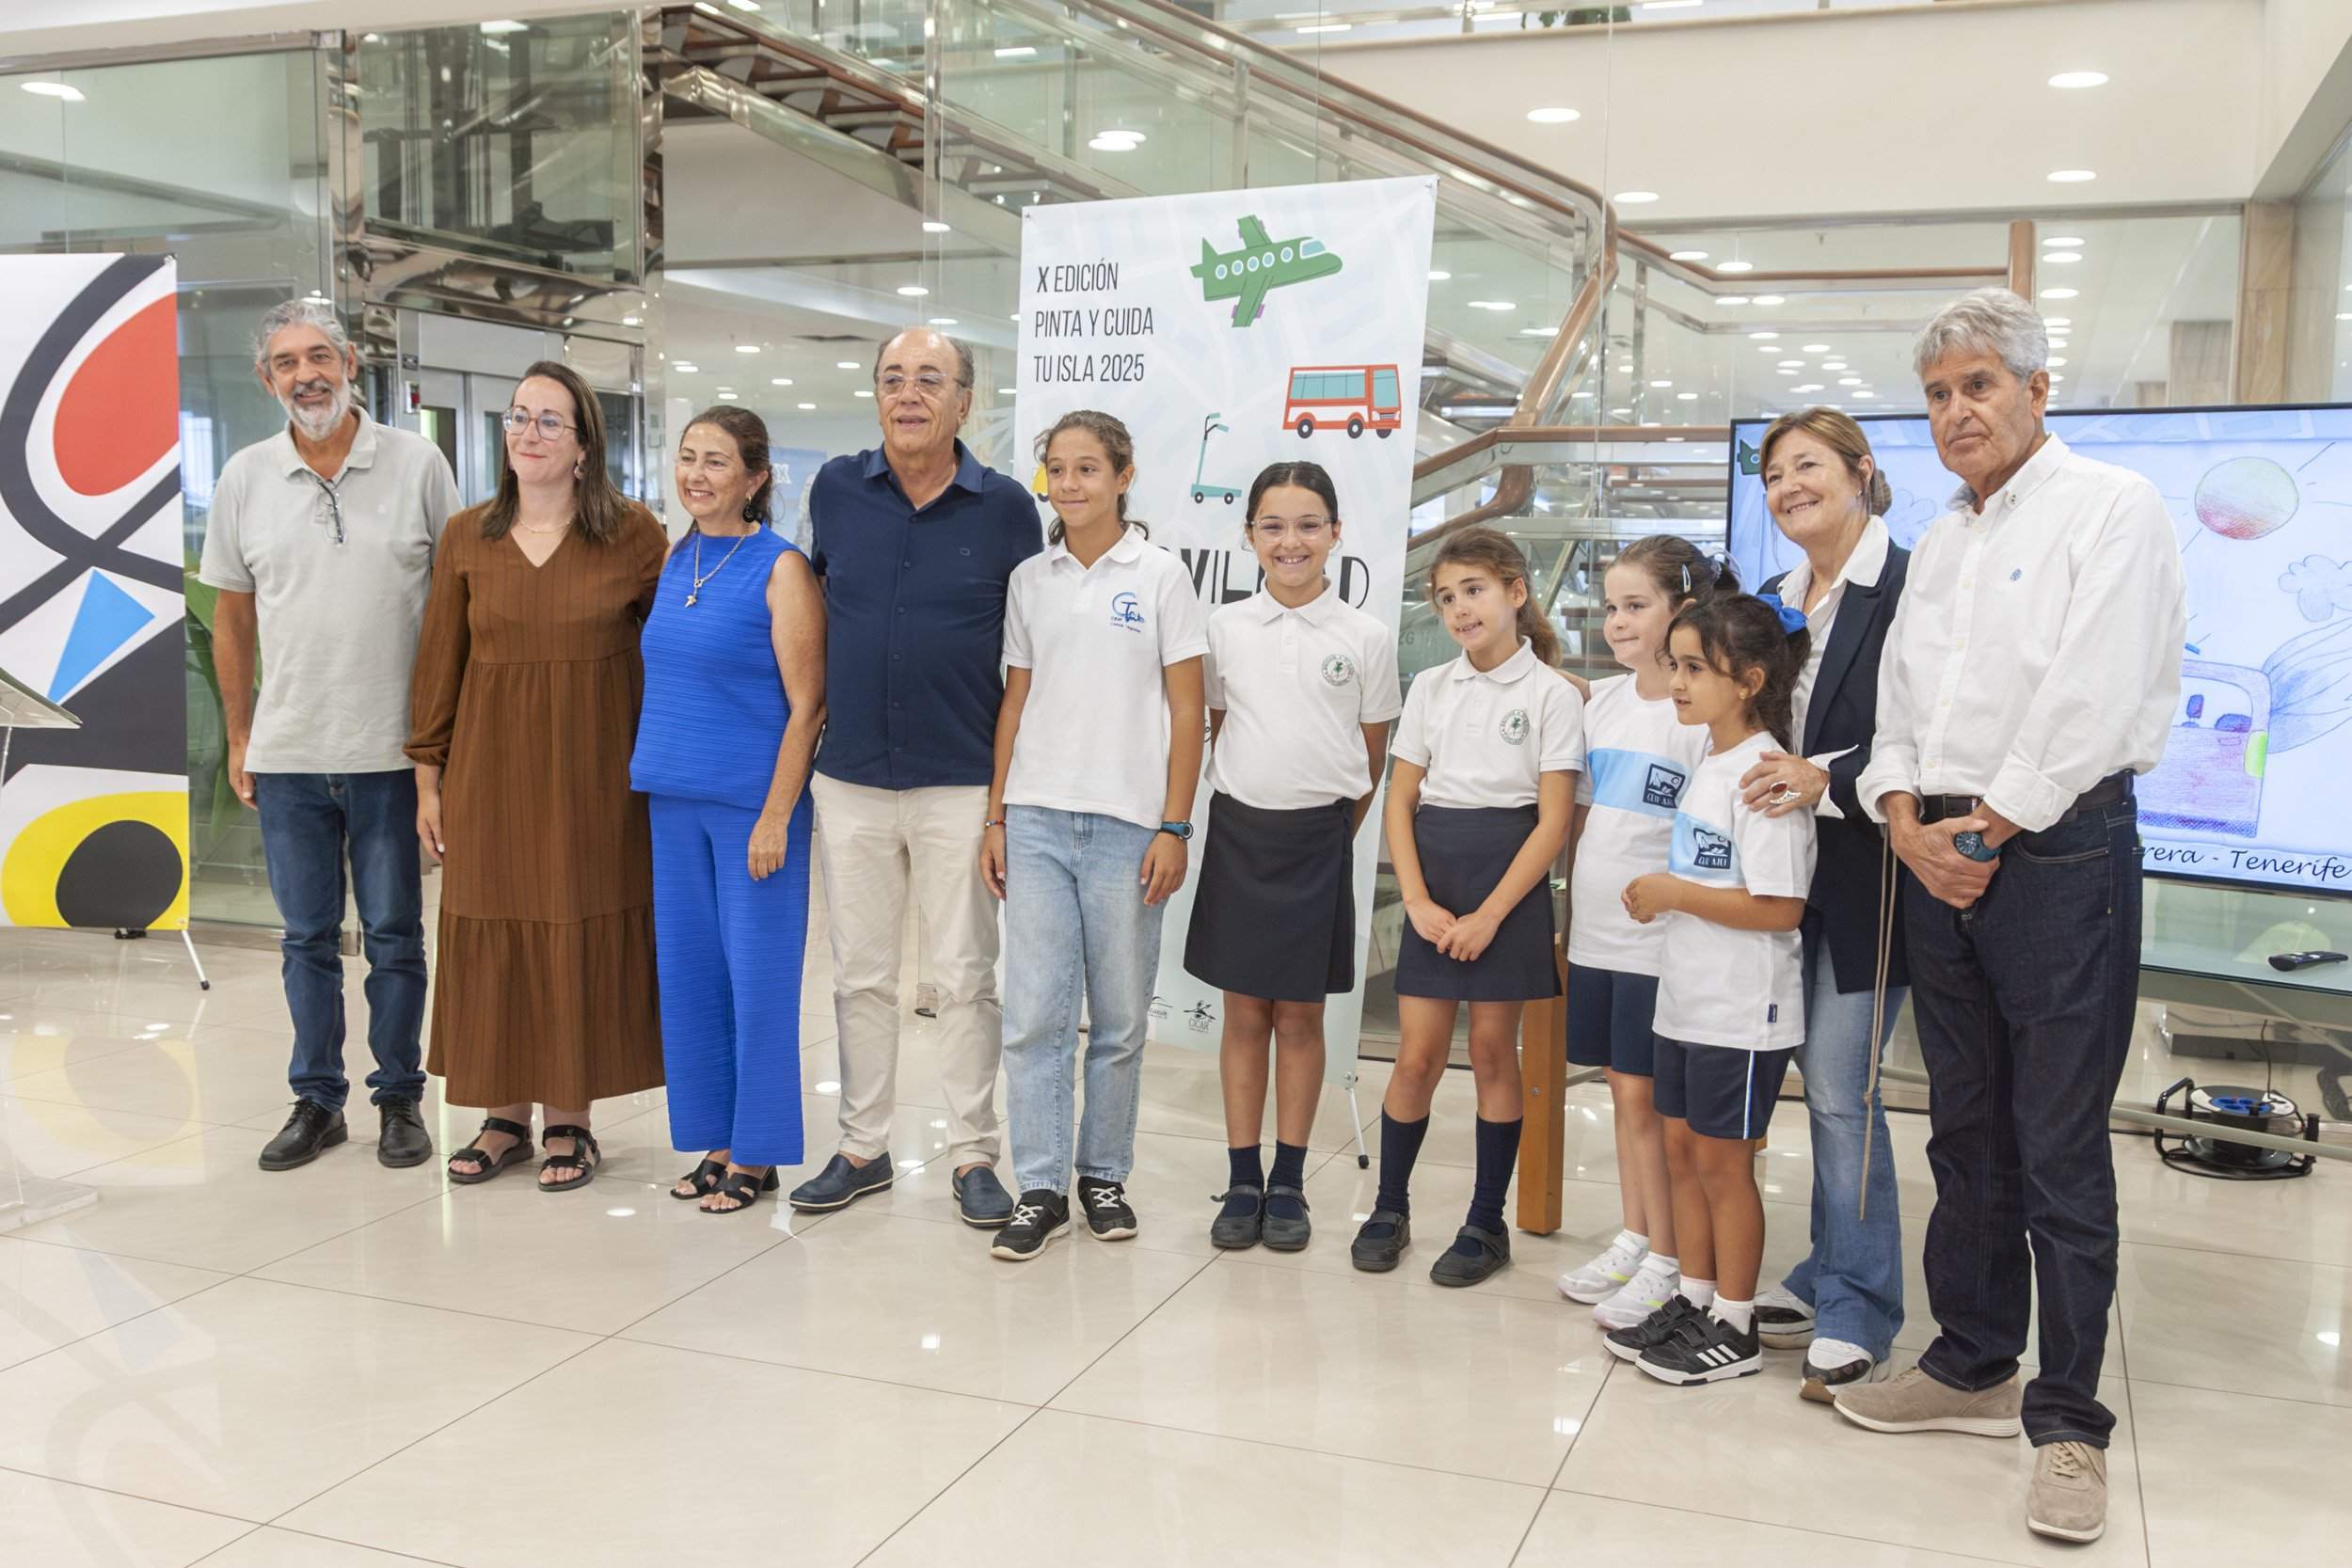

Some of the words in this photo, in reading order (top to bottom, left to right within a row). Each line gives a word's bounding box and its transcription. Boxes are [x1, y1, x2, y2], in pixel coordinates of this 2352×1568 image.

[1037, 266, 1049, 293] X
[1054, 258, 1119, 293] EDICIÓN
[1035, 309, 1082, 338] PINTA
[1089, 309, 1100, 337] Y
[1104, 307, 1153, 337] CUIDA
[1034, 355, 1053, 382] TU
[1057, 355, 1094, 382] ISLA
[1100, 354, 1145, 382] 2025
[2230, 849, 2352, 882] Tenerife
